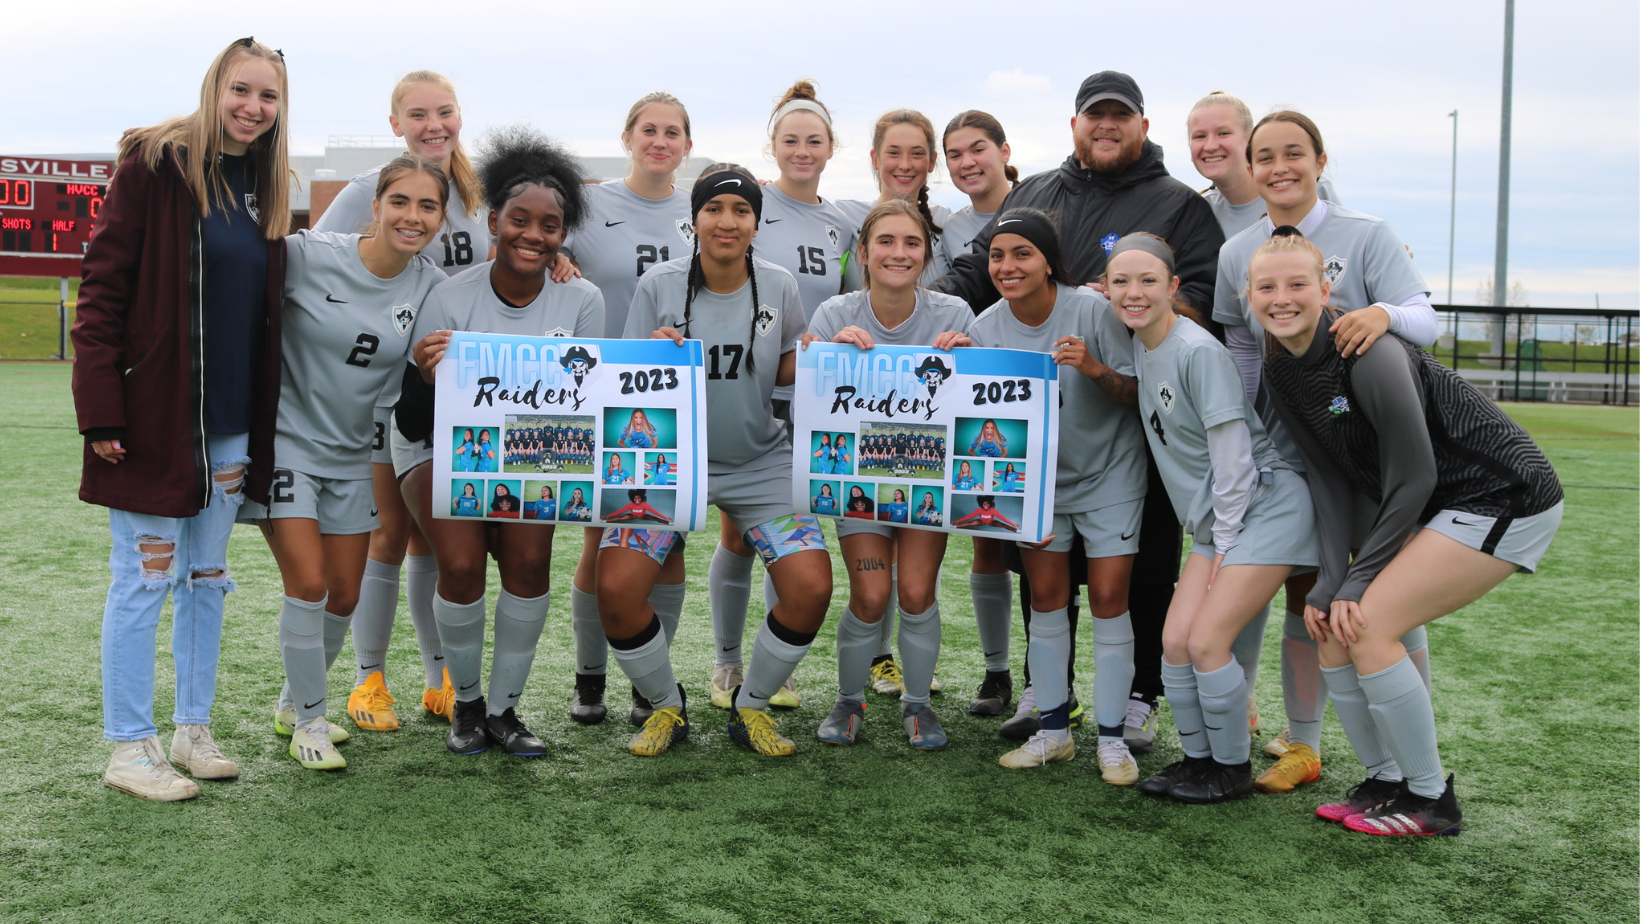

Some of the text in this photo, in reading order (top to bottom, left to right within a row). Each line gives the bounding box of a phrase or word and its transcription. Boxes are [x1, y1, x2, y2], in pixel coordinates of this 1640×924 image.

[1, 159, 107, 178] SVILLE
[66, 184, 98, 196] HVCC
[2, 218, 31, 230] SHOTS
[52, 220, 75, 231] HALF
[440, 231, 473, 267] 18
[636, 245, 669, 277] 21
[797, 245, 826, 276] 15
[345, 332, 379, 367] 2
[458, 341, 562, 390] FMCC
[708, 344, 744, 379] 17
[619, 367, 679, 395] 2023
[816, 351, 916, 401] FMCC
[972, 378, 1033, 406] 2023
[473, 376, 586, 411] Raiders
[831, 386, 939, 420] Raiders
[1150, 409, 1167, 445] 4
[272, 470, 295, 503] 2
[856, 557, 886, 571] 2004
